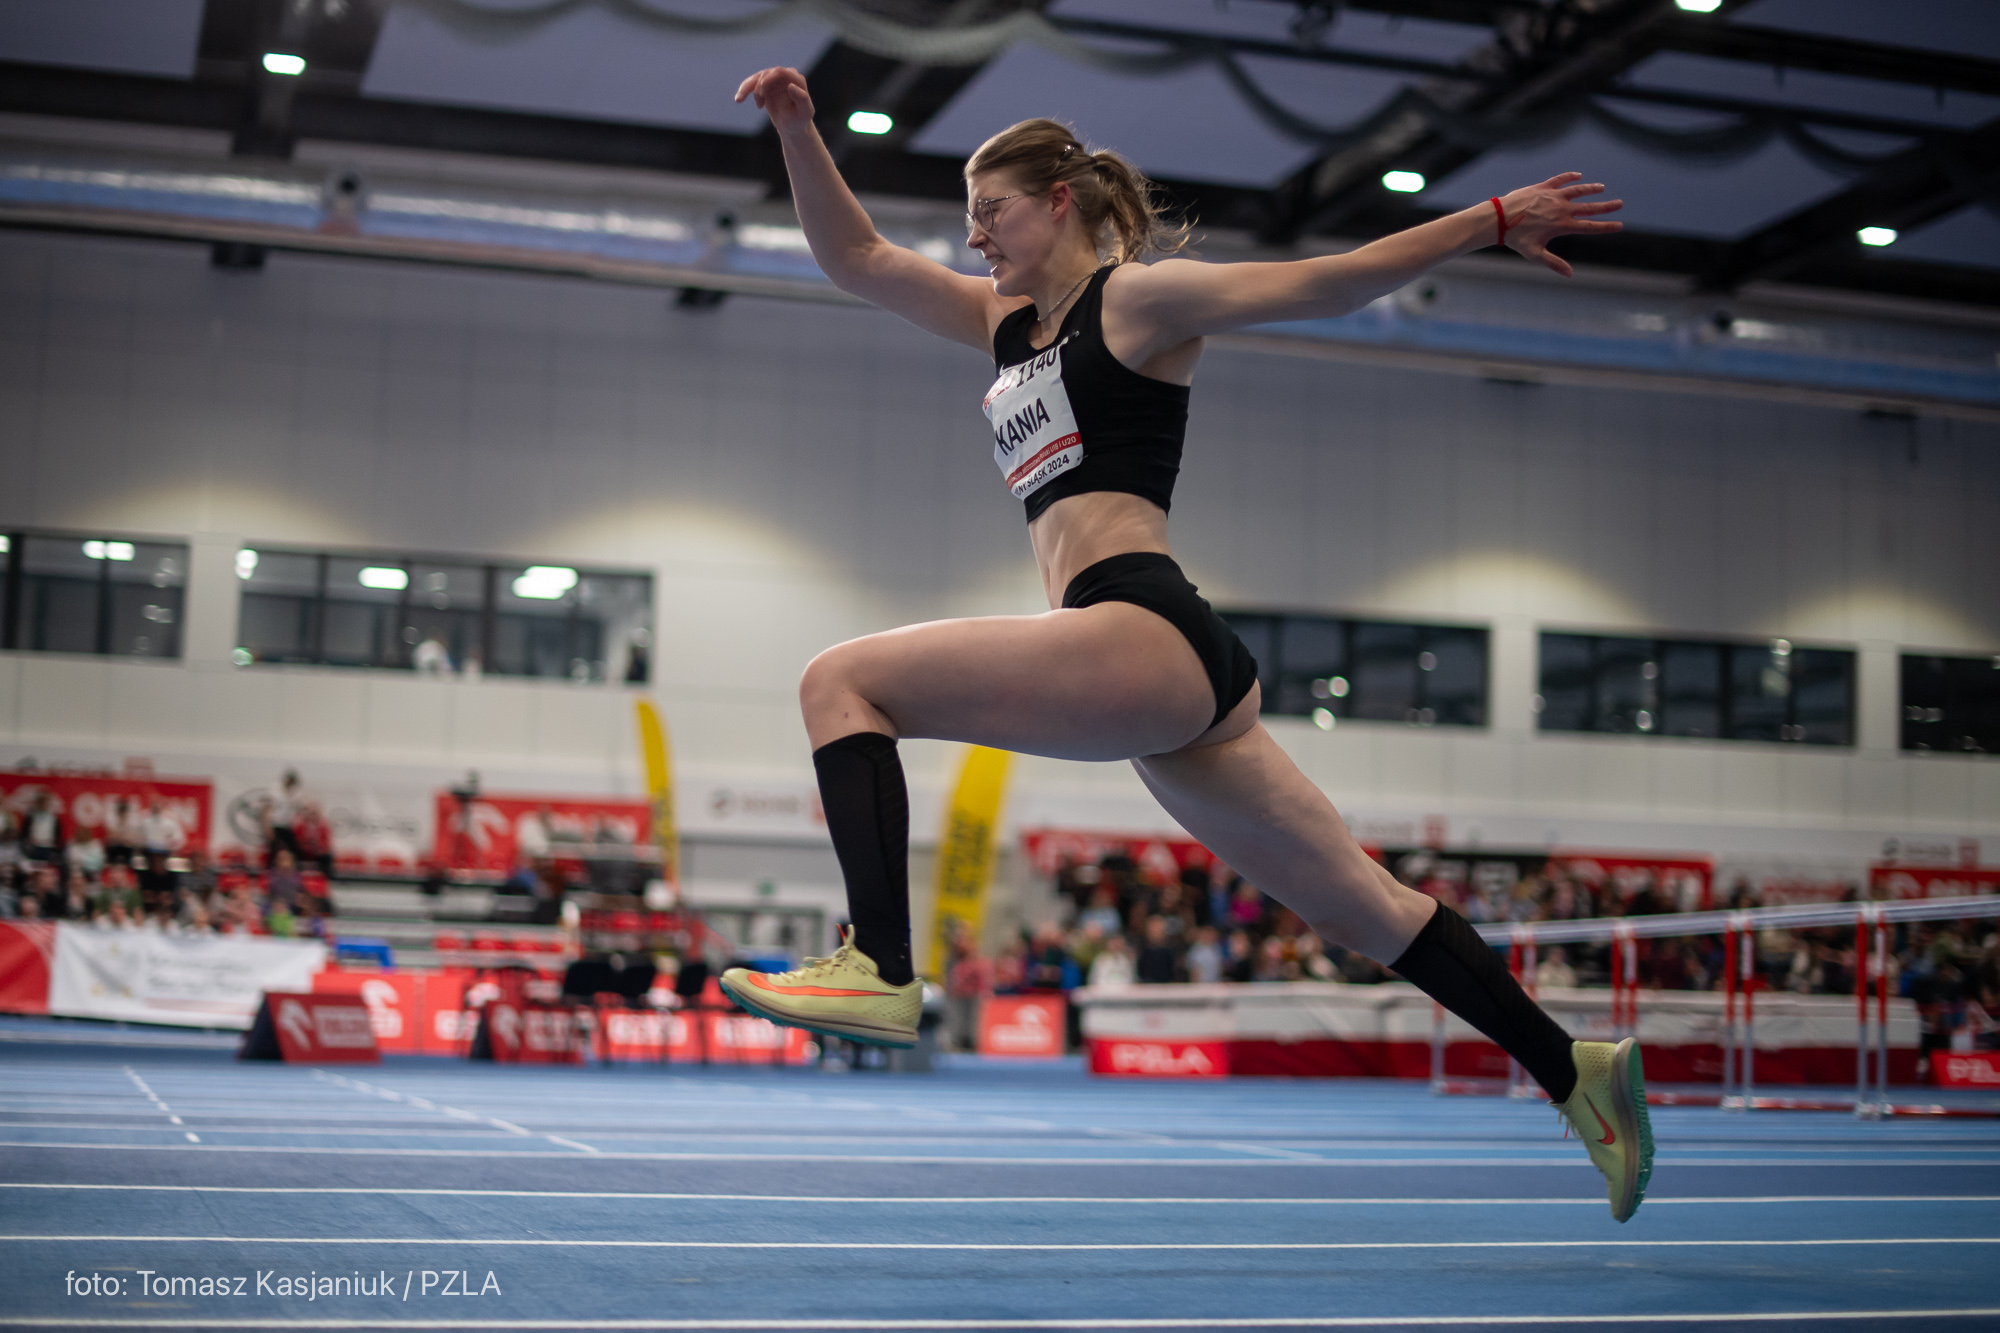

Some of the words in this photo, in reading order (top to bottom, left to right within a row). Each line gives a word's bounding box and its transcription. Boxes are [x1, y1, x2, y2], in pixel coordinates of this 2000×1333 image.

[1016, 346, 1057, 389] 1140
[995, 397, 1051, 456] KANIA
[1061, 435, 1077, 447] U20
[1047, 453, 1071, 474] 2024
